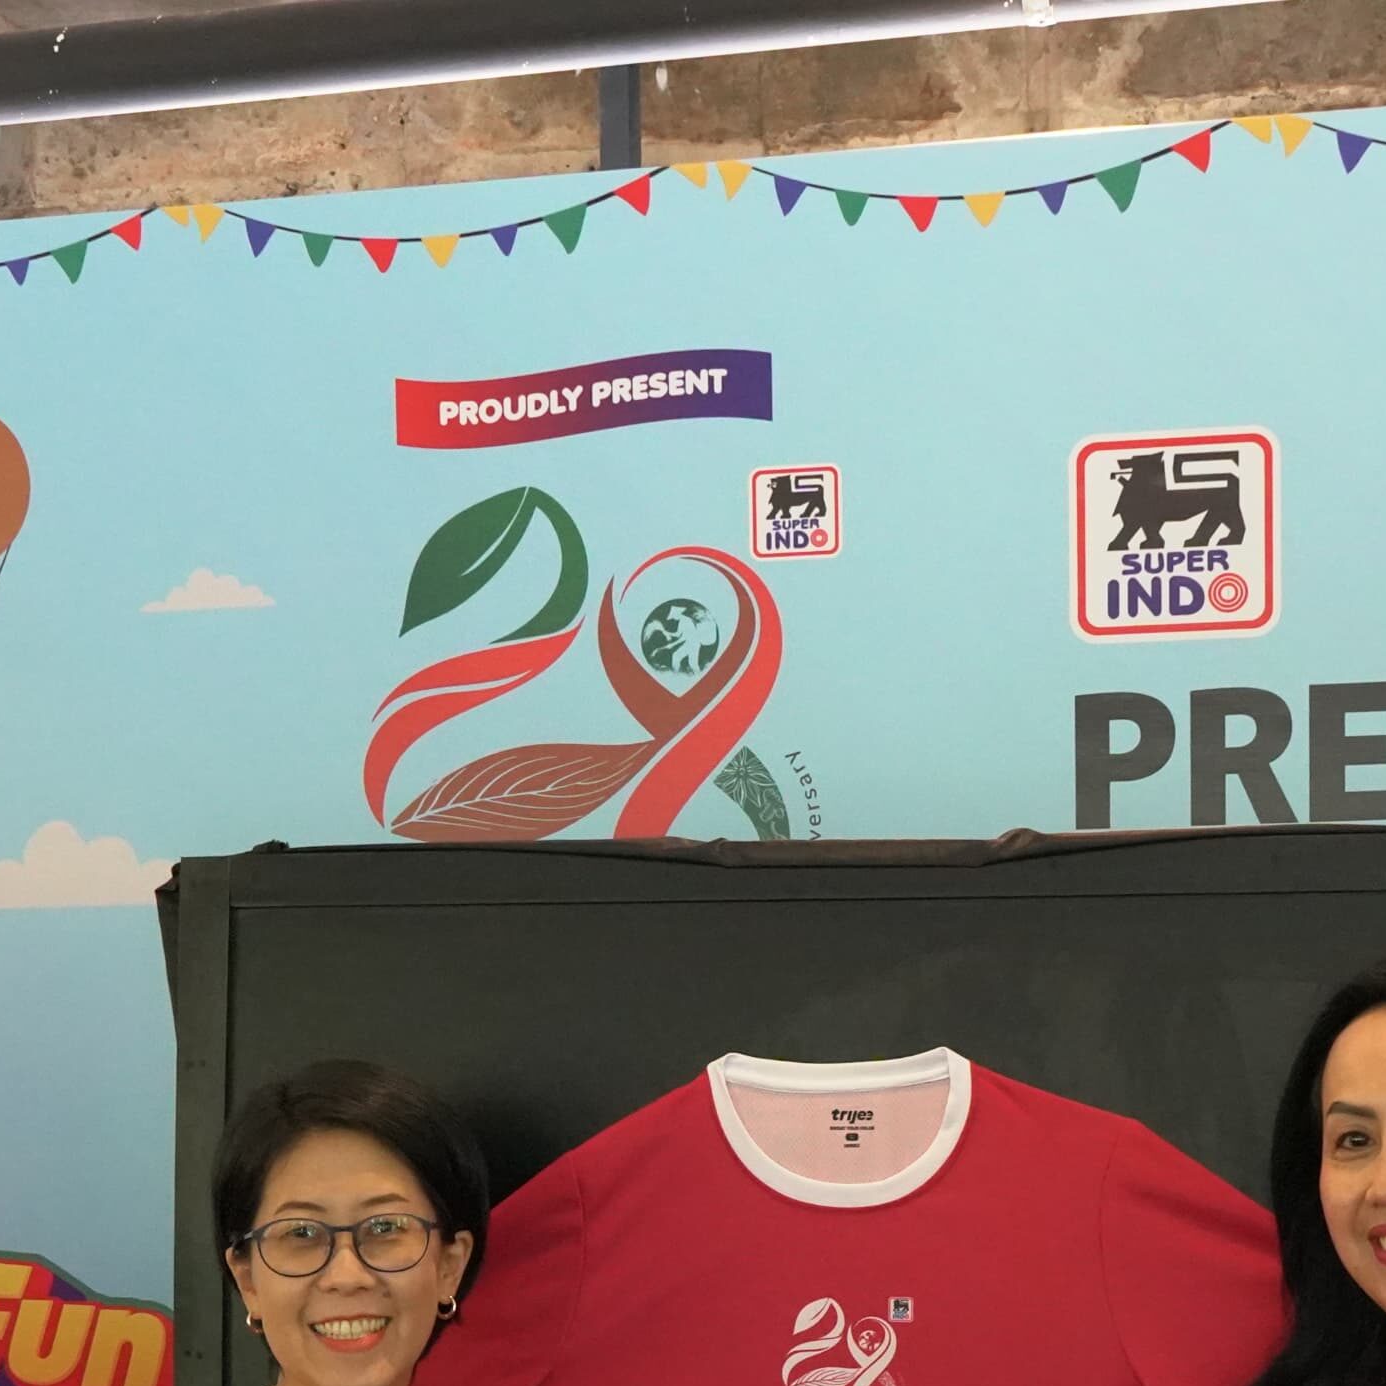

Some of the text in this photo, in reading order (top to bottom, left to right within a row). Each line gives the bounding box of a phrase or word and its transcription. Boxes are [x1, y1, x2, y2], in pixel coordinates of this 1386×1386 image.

[439, 368, 728, 427] PROUDLY PRESENT
[772, 518, 820, 531] SUPER
[766, 529, 829, 551] INDO
[1121, 549, 1230, 576] SUPER
[1107, 572, 1249, 620] INDO
